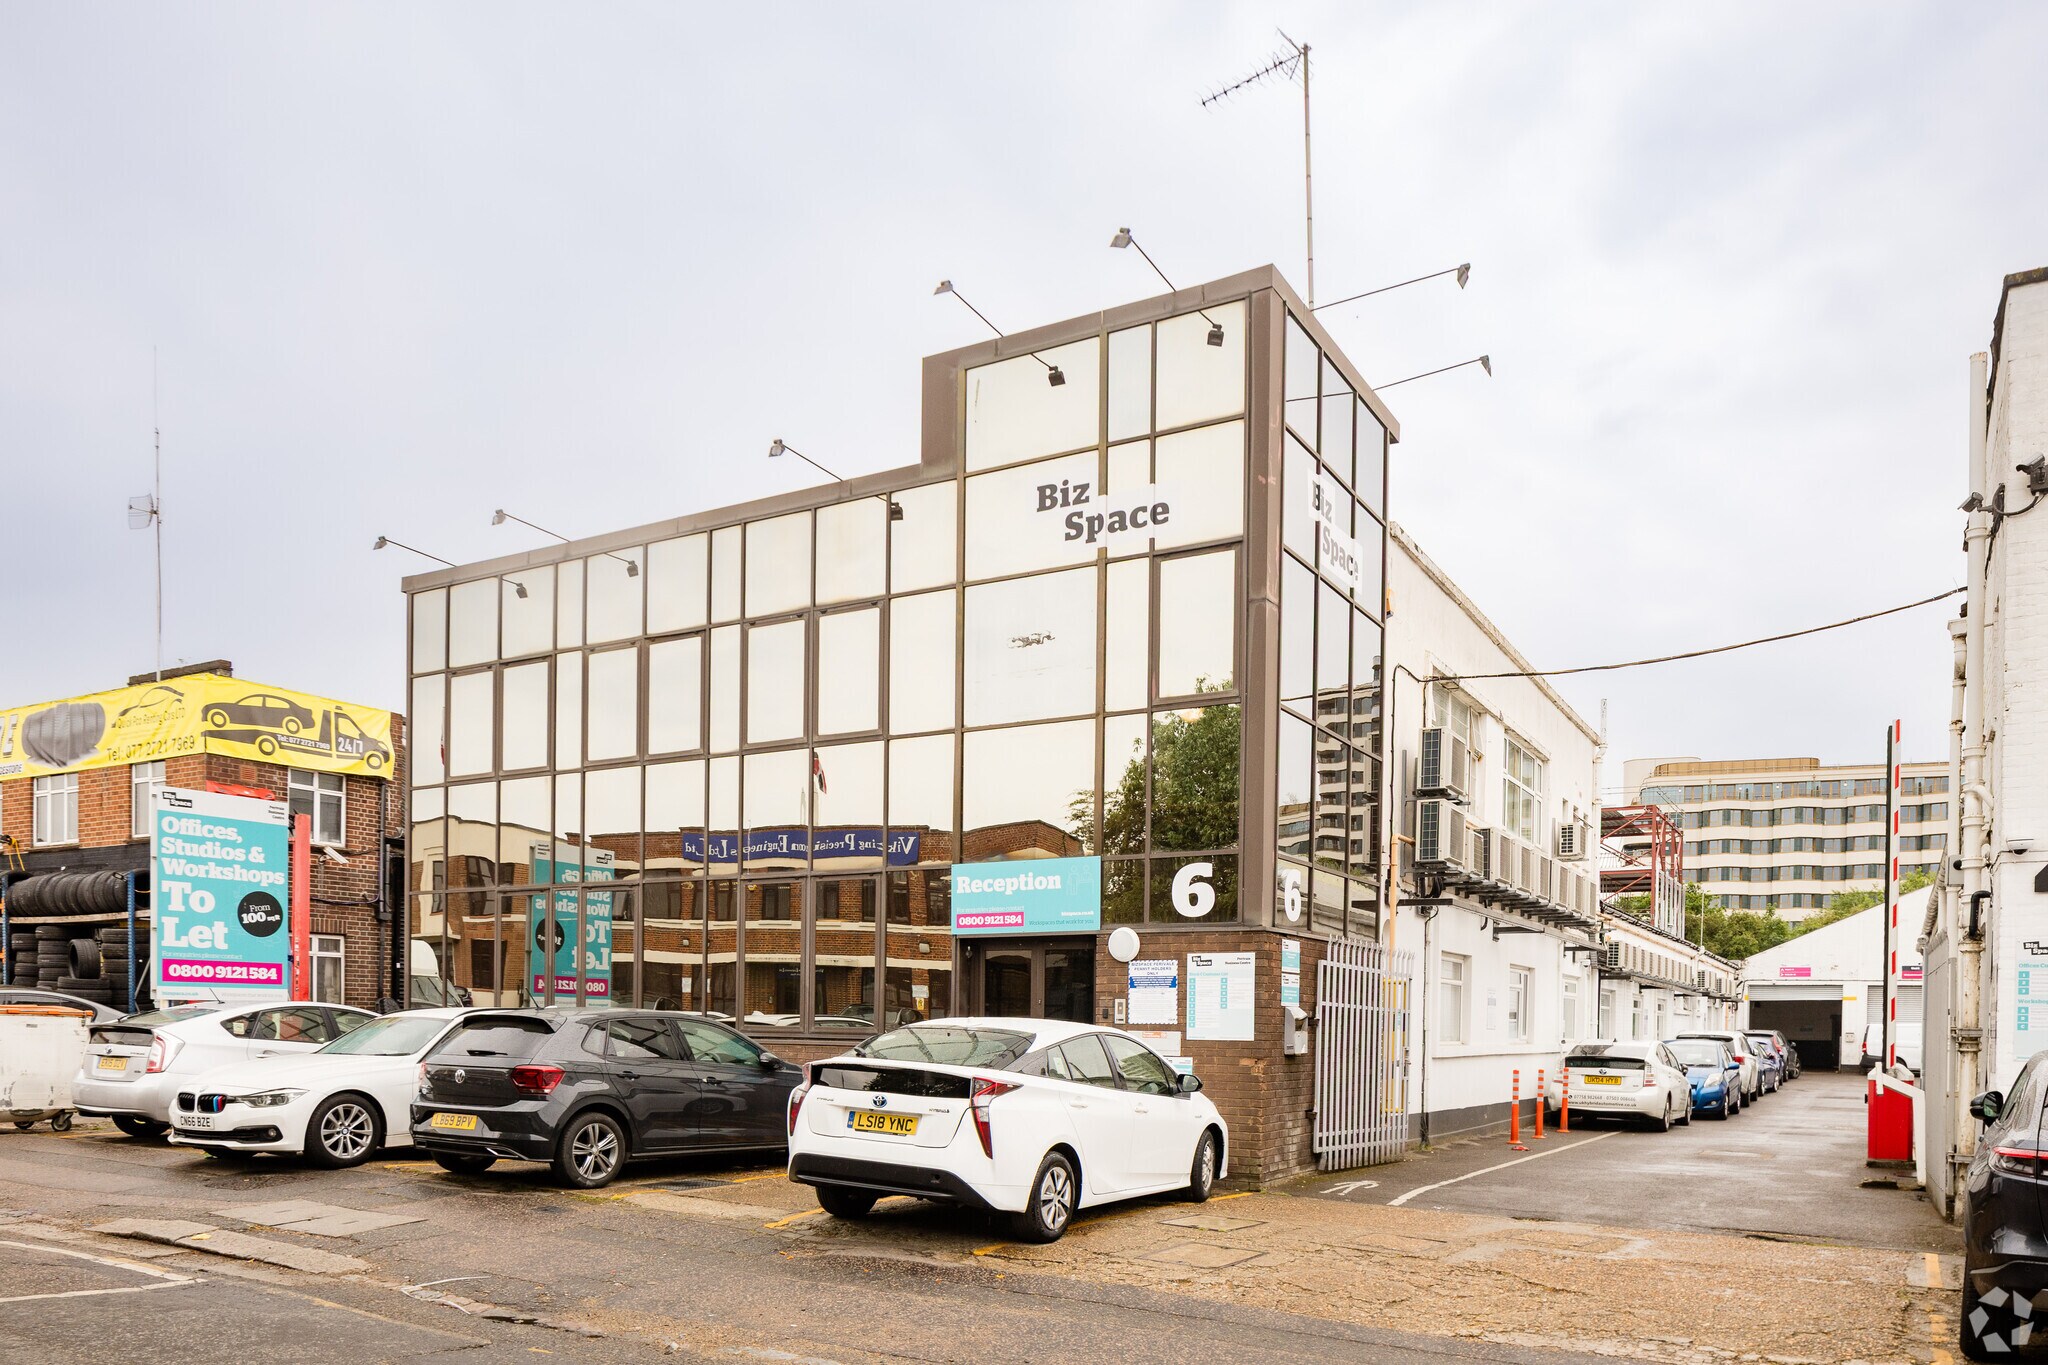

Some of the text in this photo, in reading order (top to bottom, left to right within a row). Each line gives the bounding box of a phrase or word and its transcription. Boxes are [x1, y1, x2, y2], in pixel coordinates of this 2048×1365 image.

[1036, 479, 1090, 512] Biz
[1312, 480, 1332, 523] Biz
[1064, 500, 1170, 544] Space
[1323, 526, 1358, 581] Space
[107, 736, 195, 761] Tel: 077 2721 7969
[277, 734, 289, 743] Tel:
[289, 736, 300, 744] 077
[301, 738, 315, 747] 2721
[338, 737, 363, 754] 24/7
[161, 816, 243, 843] Offices,
[161, 837, 265, 863] Studios &
[161, 857, 285, 887] Workshops
[957, 872, 1061, 895] Reception
[161, 880, 216, 914] To
[1172, 862, 1215, 918] 6
[1285, 869, 1301, 922] 6
[241, 912, 266, 924] 100
[249, 904, 271, 912] From
[959, 916, 983, 926] 0800
[161, 916, 228, 950] Let
[168, 964, 214, 978] 0800
[180, 1116, 210, 1127] CN66 BZE
[435, 1115, 473, 1127] LB69 BPV
[857, 1114, 913, 1132] LS18 YNC
